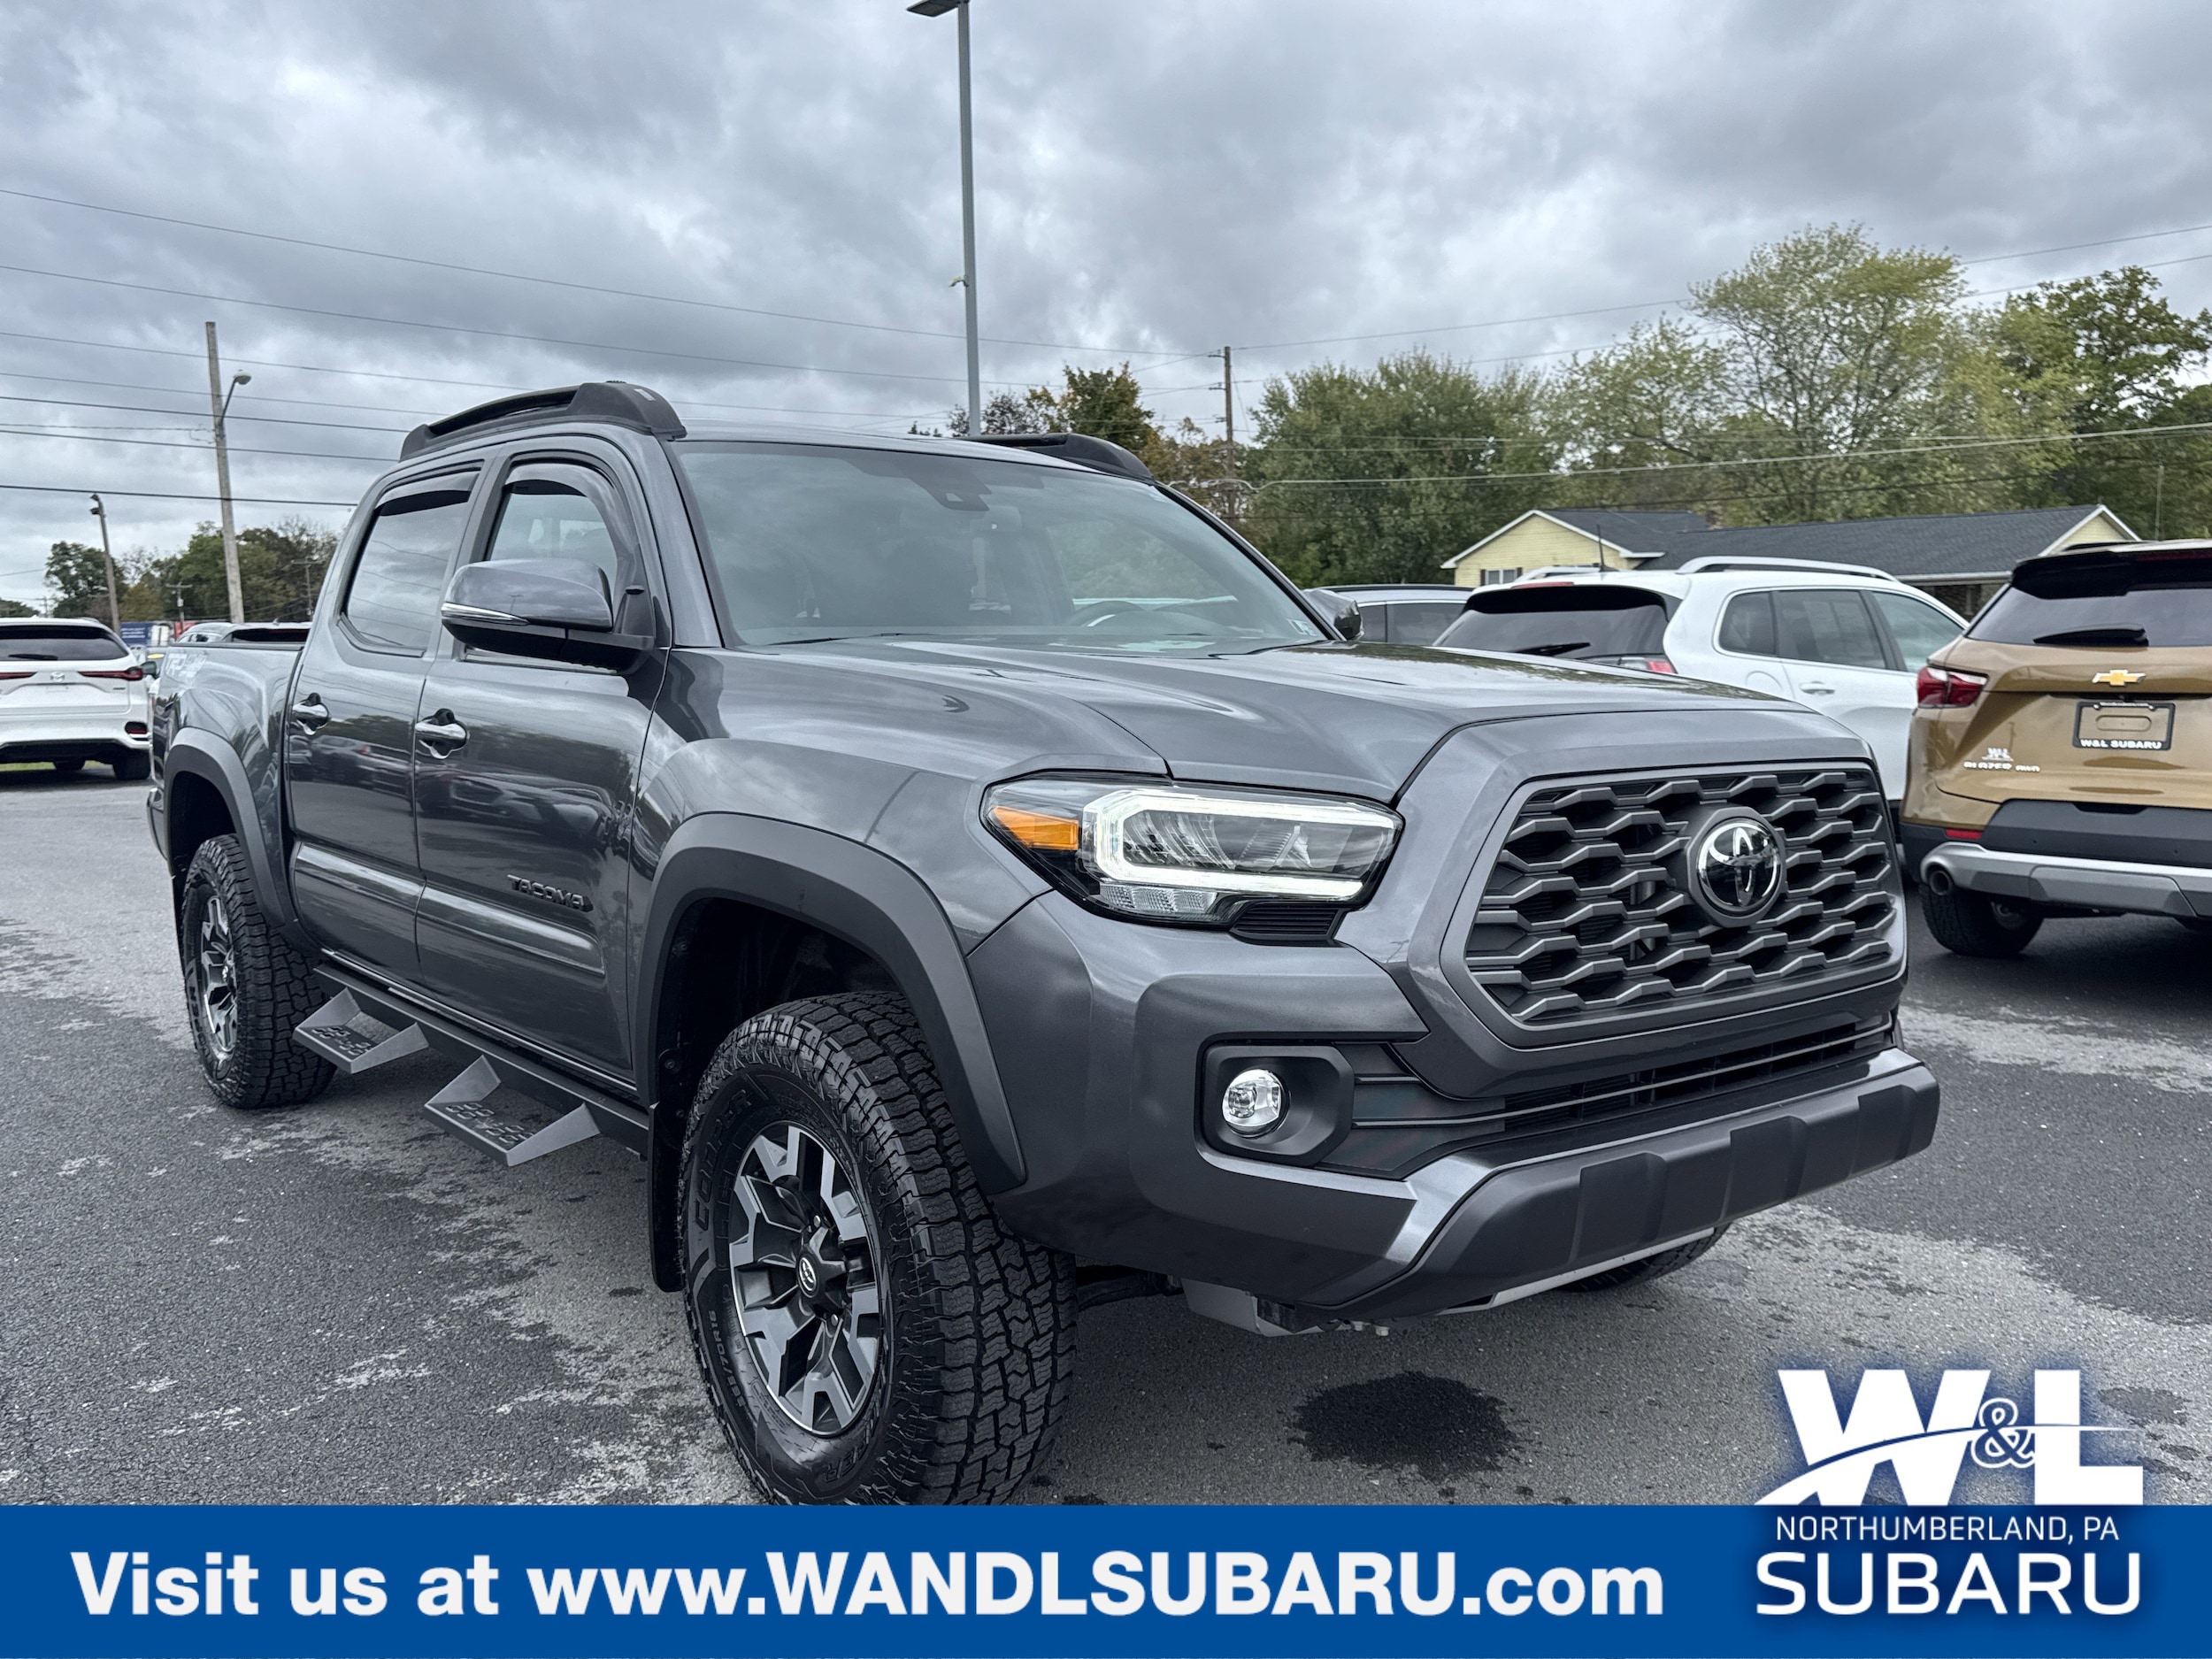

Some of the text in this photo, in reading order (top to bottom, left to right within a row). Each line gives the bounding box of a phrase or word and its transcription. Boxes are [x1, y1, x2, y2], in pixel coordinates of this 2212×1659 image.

[2080, 739, 2162, 749] W&L SUBARU
[507, 873, 592, 912] TACOMA
